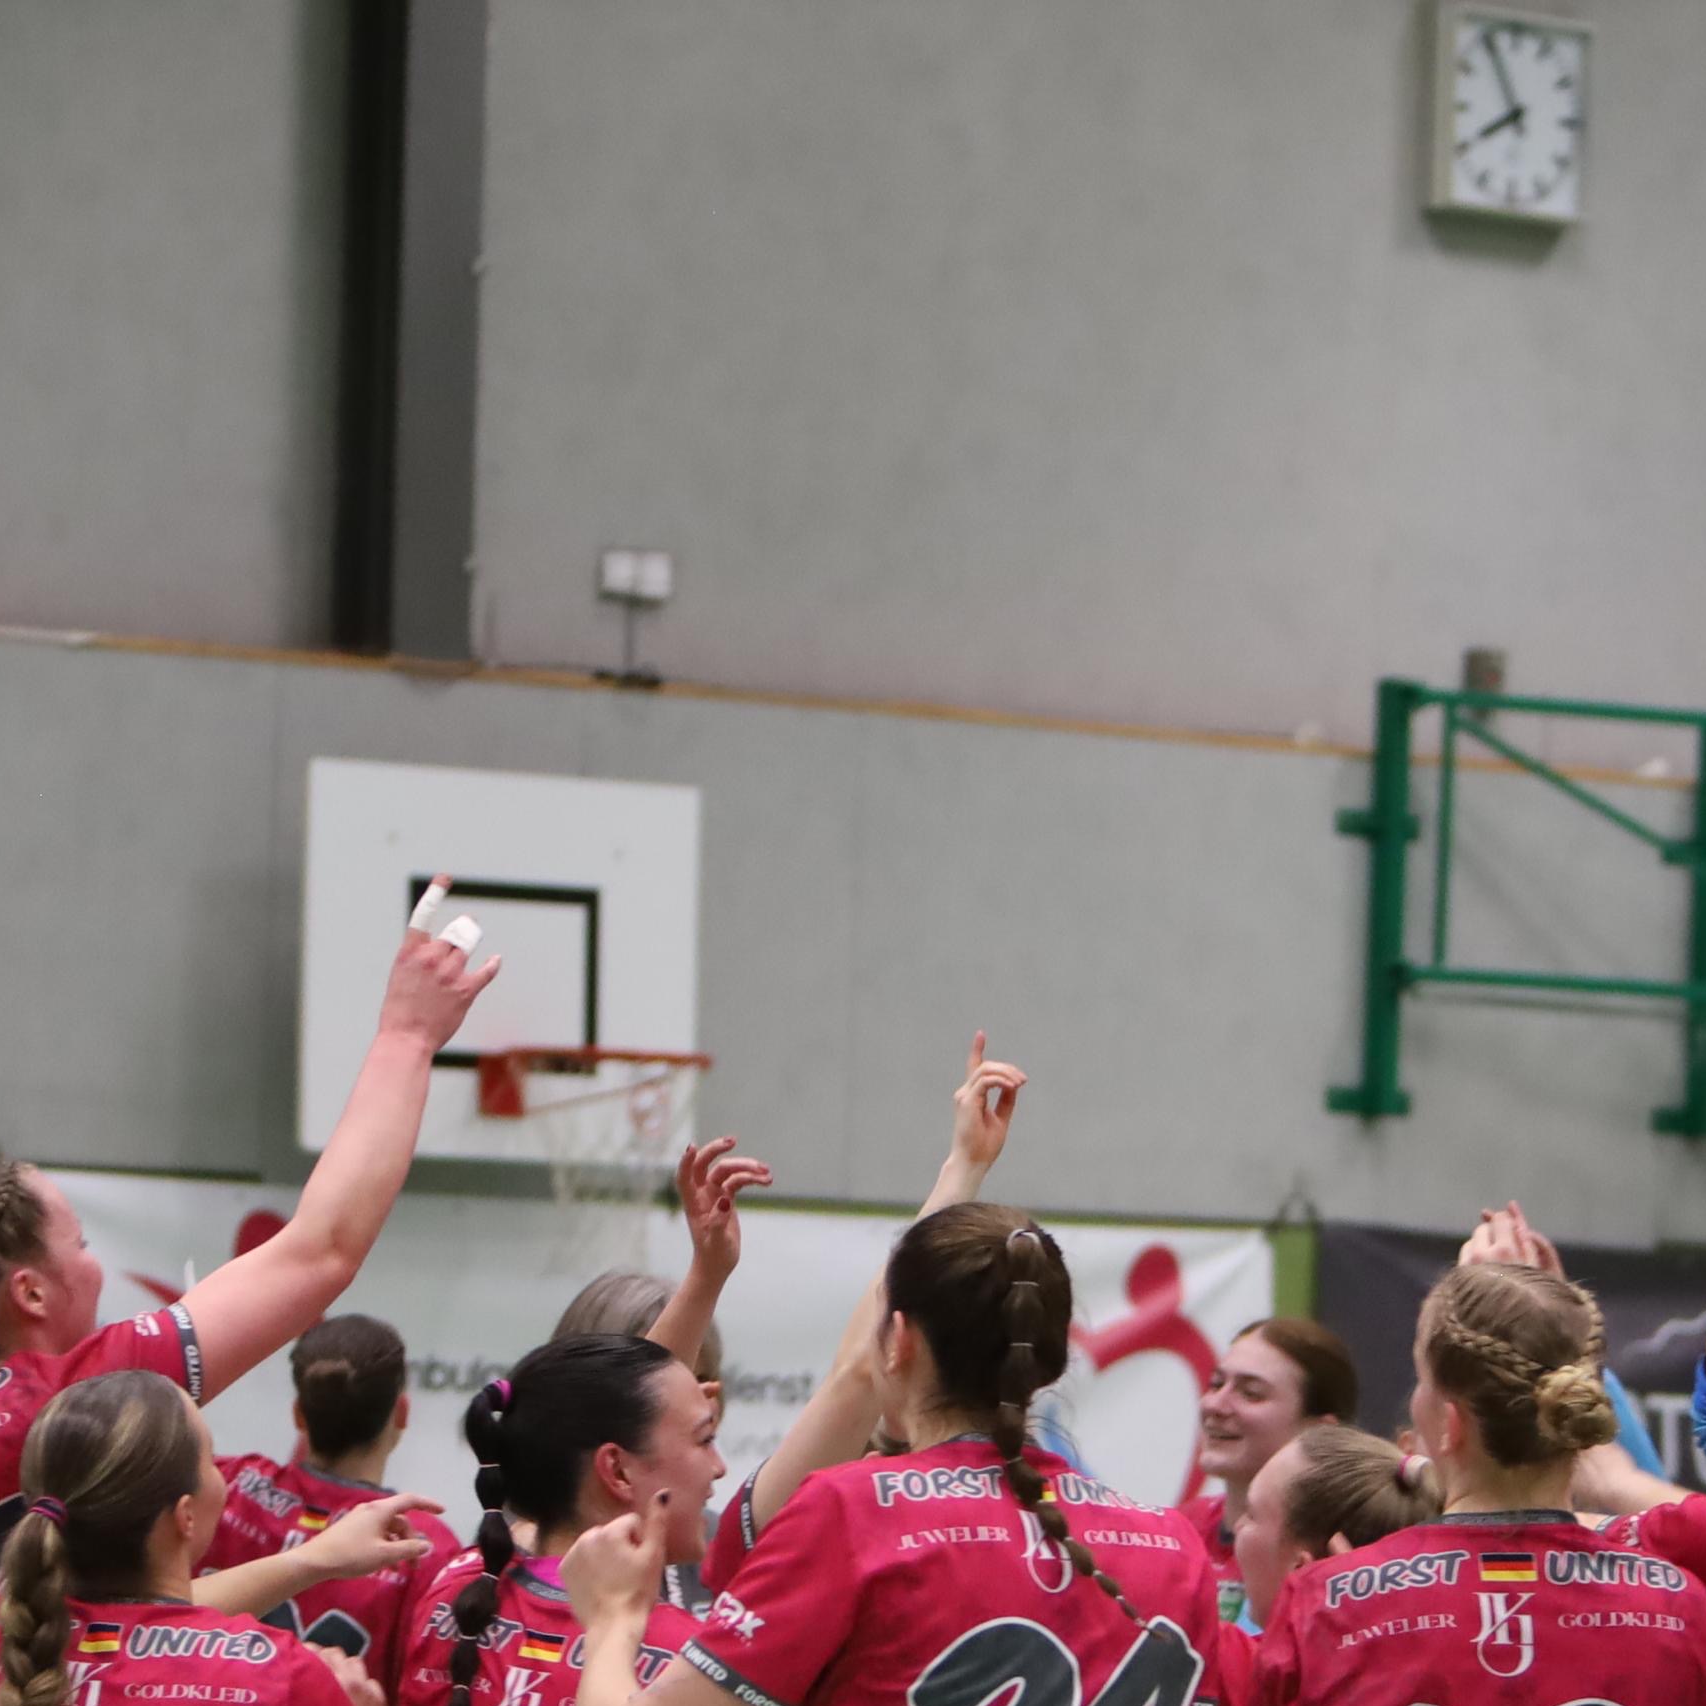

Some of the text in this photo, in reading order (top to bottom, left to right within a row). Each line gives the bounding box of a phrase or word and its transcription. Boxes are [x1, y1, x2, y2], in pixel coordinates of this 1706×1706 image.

[871, 1465, 1004, 1508] FORST
[897, 1525, 1011, 1551] JUWELIER
[1324, 1549, 1688, 1609] FORST UNITED
[125, 1623, 277, 1664] UNITED
[1336, 1611, 1686, 1650] JUWELIER GOLDKLEID
[123, 1683, 258, 1704] GOLDKLEID
